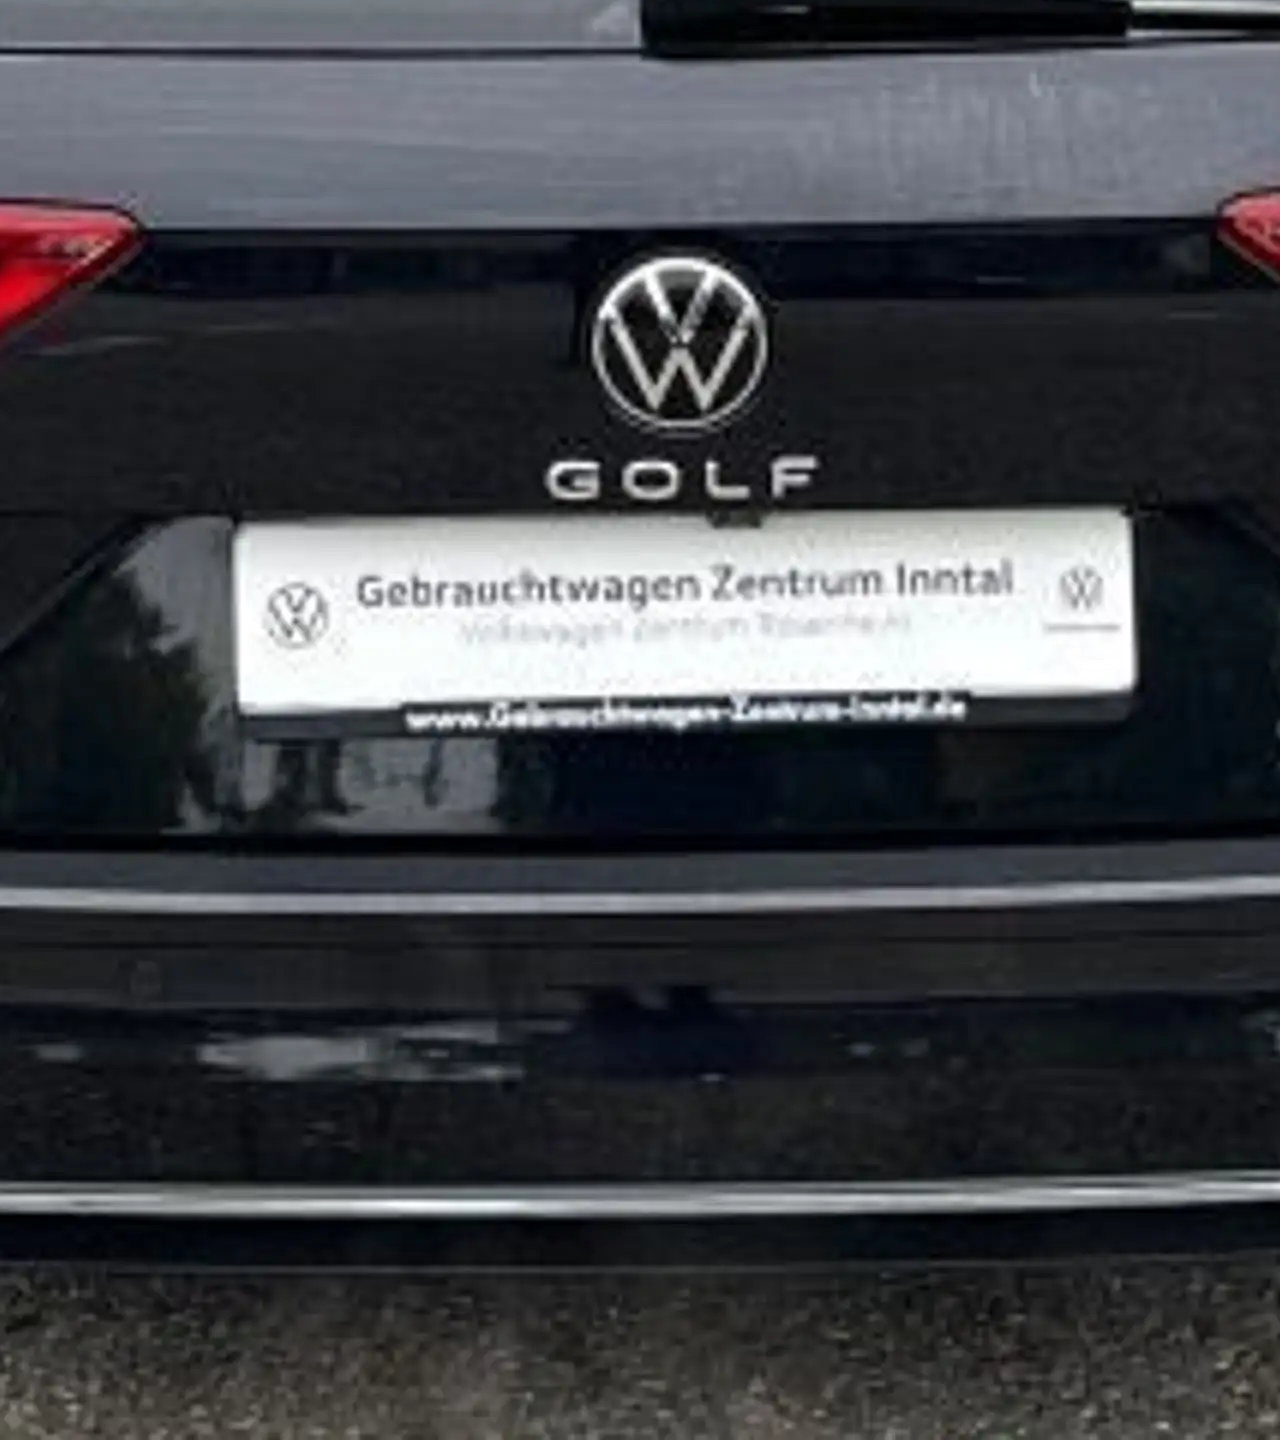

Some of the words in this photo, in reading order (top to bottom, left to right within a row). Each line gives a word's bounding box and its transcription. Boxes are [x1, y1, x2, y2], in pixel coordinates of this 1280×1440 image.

[544, 454, 819, 501] GOLF
[356, 569, 704, 612] Gebrauchtwagen
[709, 562, 883, 603] Zentrum
[895, 558, 1016, 597] Inntal
[404, 692, 969, 732] www.Gebrauchtwagen-Zentrum-Inntal.de
